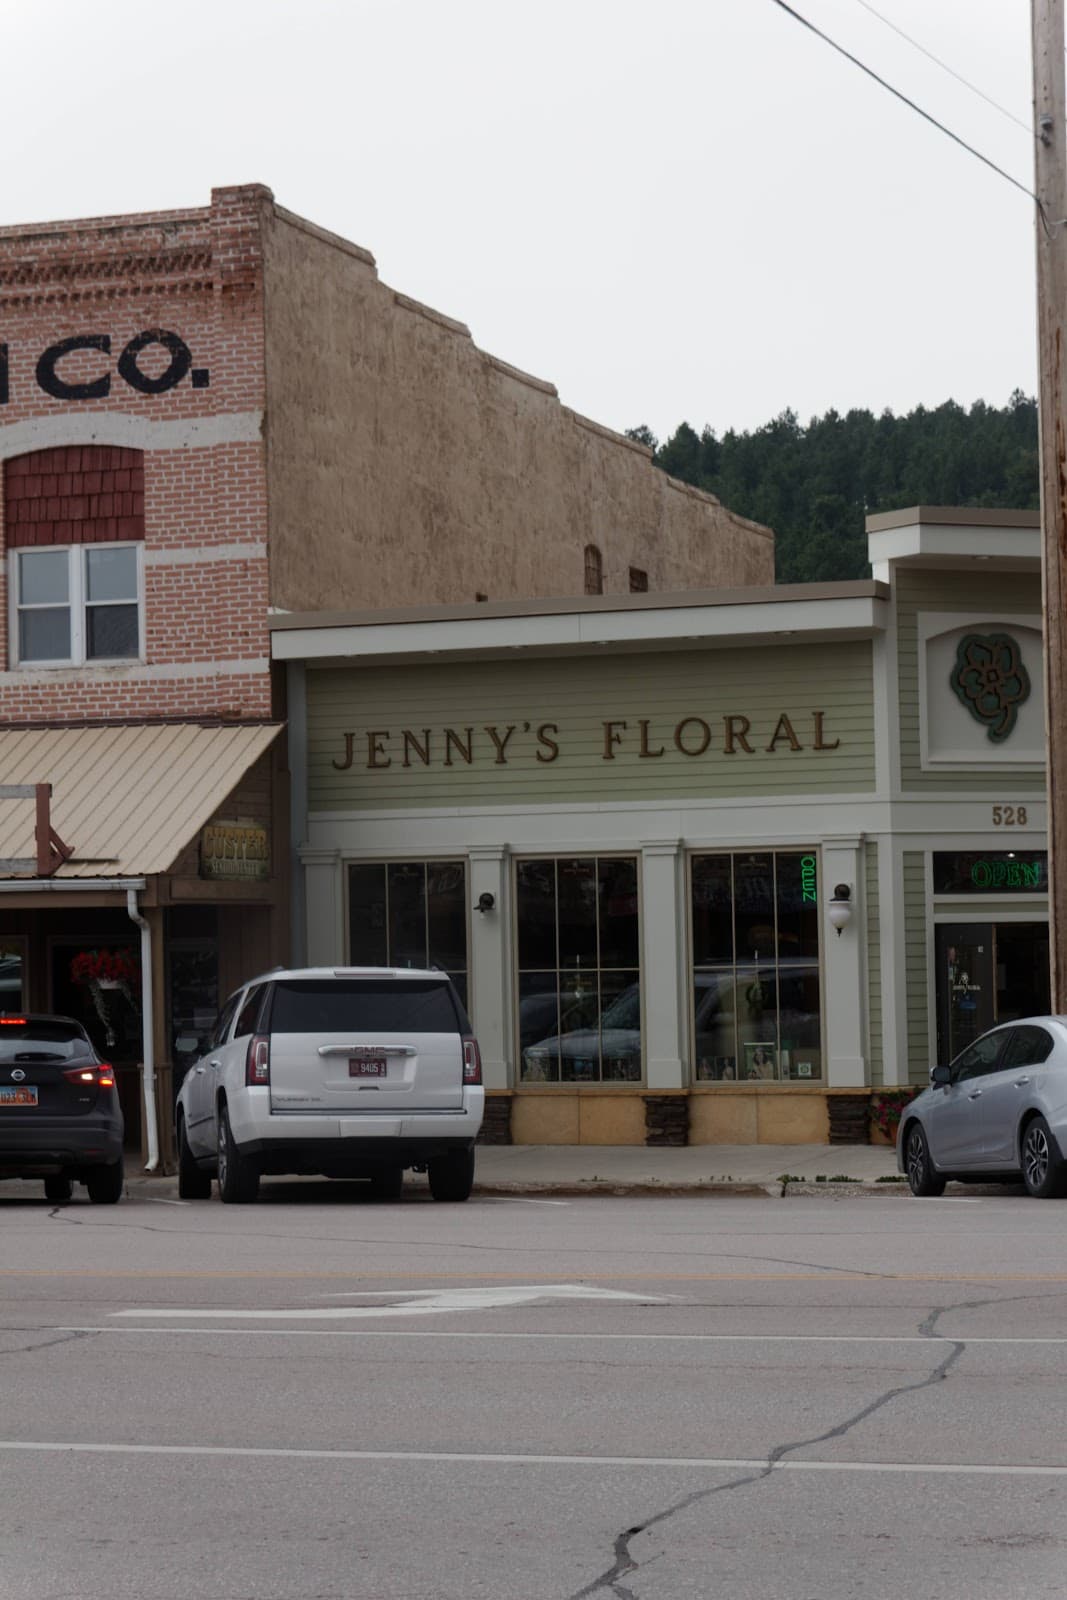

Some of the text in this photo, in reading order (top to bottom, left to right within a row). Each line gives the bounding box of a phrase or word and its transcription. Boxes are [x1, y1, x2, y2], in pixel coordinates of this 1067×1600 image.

[36, 328, 209, 400] CO.
[332, 711, 840, 770] JENNY'S FLORAL
[992, 806, 1028, 825] 528
[801, 855, 817, 903] OPEN
[971, 860, 1040, 887] OPEN
